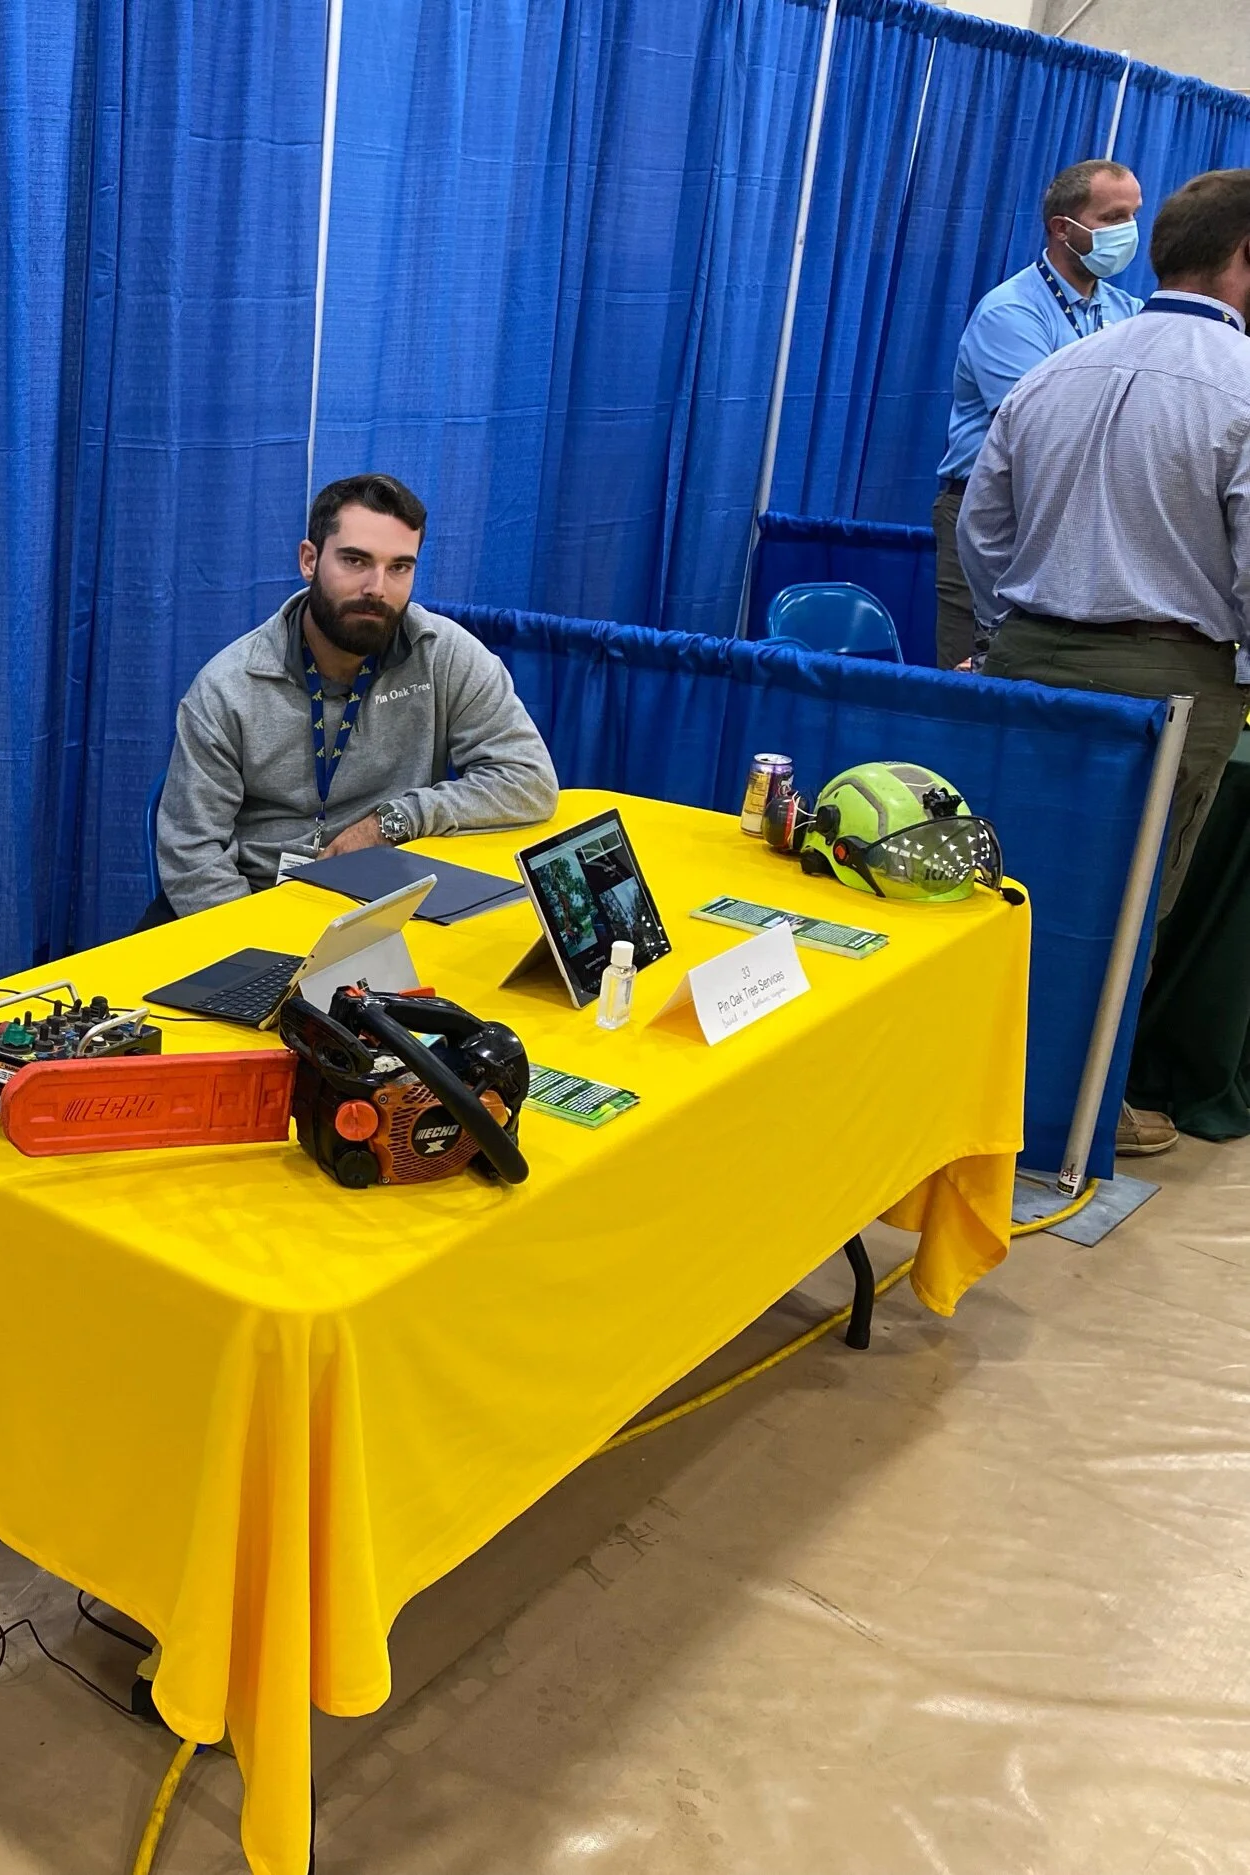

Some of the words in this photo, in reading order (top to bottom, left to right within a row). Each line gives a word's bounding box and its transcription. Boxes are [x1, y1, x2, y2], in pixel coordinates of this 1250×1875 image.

[374, 694, 388, 705] Pin
[389, 688, 410, 700] Oak
[409, 682, 431, 693] Tree
[717, 999, 730, 1014] Pin
[729, 991, 743, 1007] Oak
[742, 984, 759, 999] Tree
[758, 970, 785, 991] Services
[82, 1094, 161, 1122] ECHO
[423, 1124, 459, 1139] ECHO
